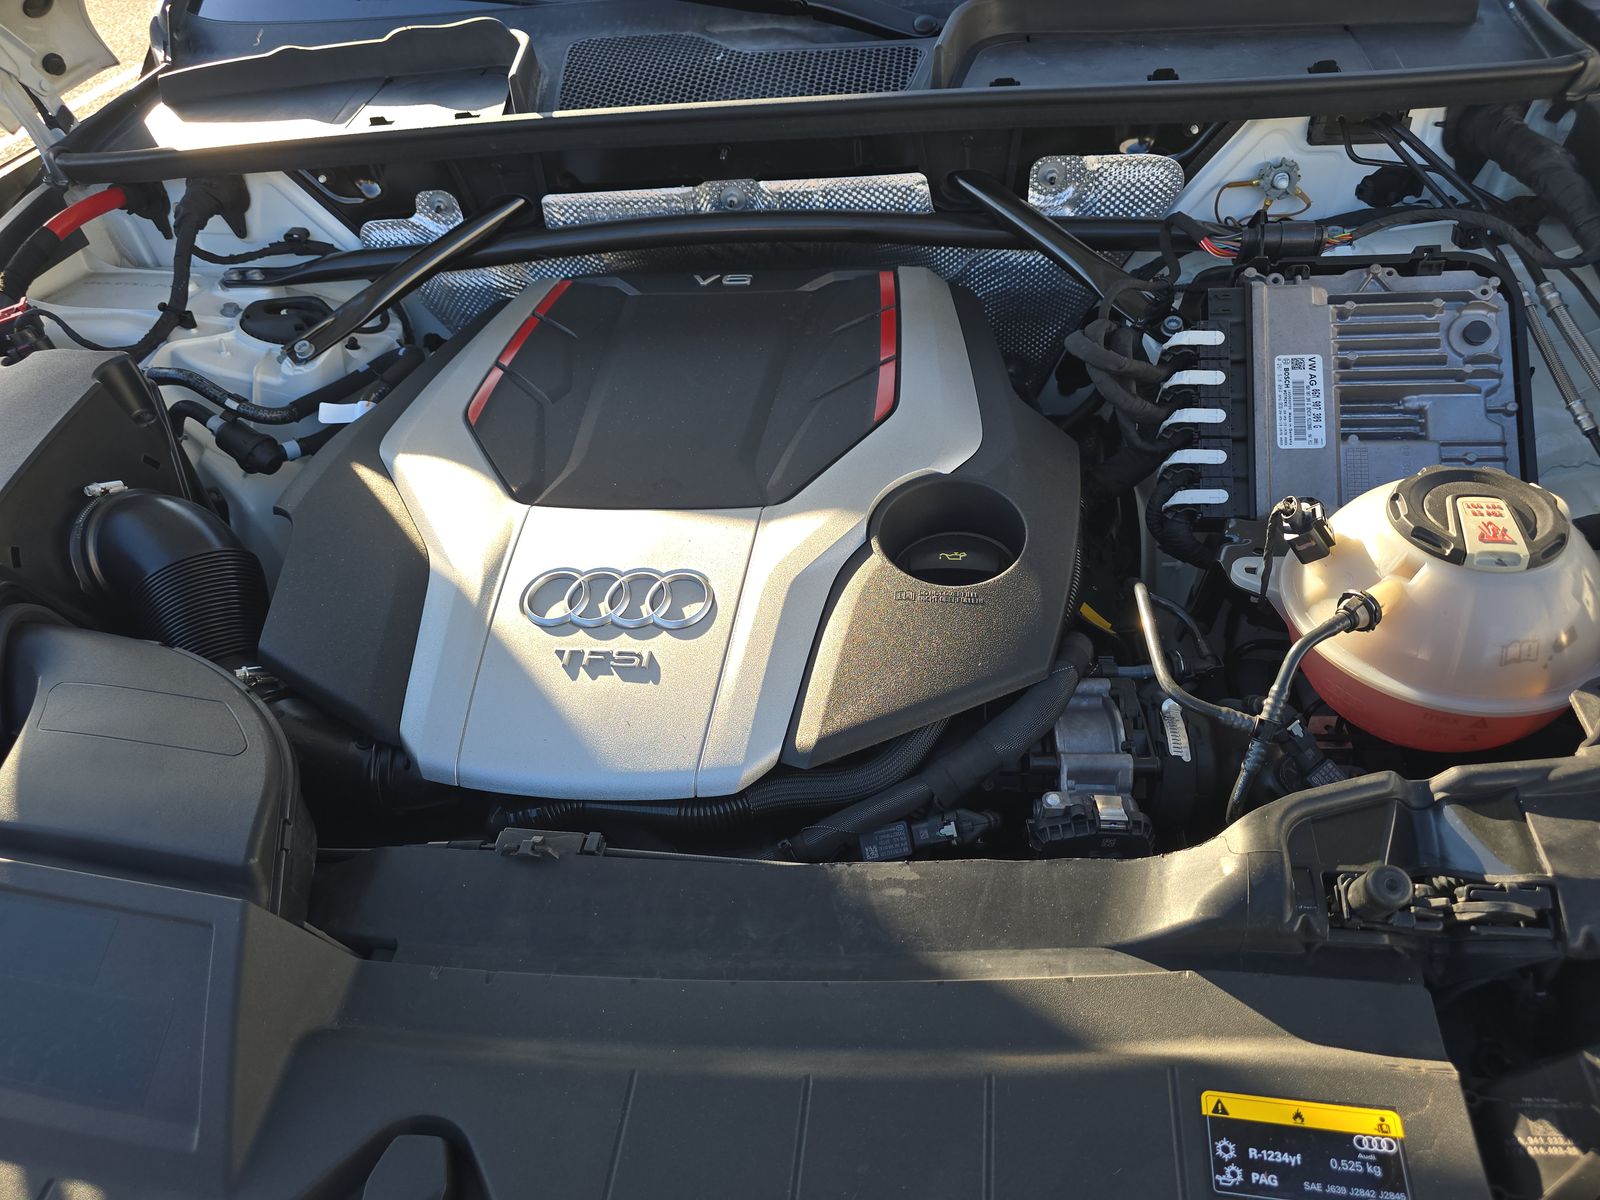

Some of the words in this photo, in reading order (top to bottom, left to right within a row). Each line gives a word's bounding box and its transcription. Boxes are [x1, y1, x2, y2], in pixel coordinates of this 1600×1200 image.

[693, 273, 753, 285] V6
[1308, 357, 1317, 371] VW
[1309, 373, 1317, 386] AG
[554, 648, 653, 670] TFSI
[1248, 1147, 1302, 1165] R-1234yf
[1329, 1158, 1363, 1173] 0,525
[1366, 1162, 1383, 1177] kg
[1357, 1152, 1376, 1161] Audi
[1251, 1171, 1279, 1187] PAG
[1303, 1181, 1323, 1192] SAE
[1325, 1184, 1347, 1195] J639
[1349, 1187, 1376, 1198] J2842
[1379, 1190, 1406, 1200] J2845
